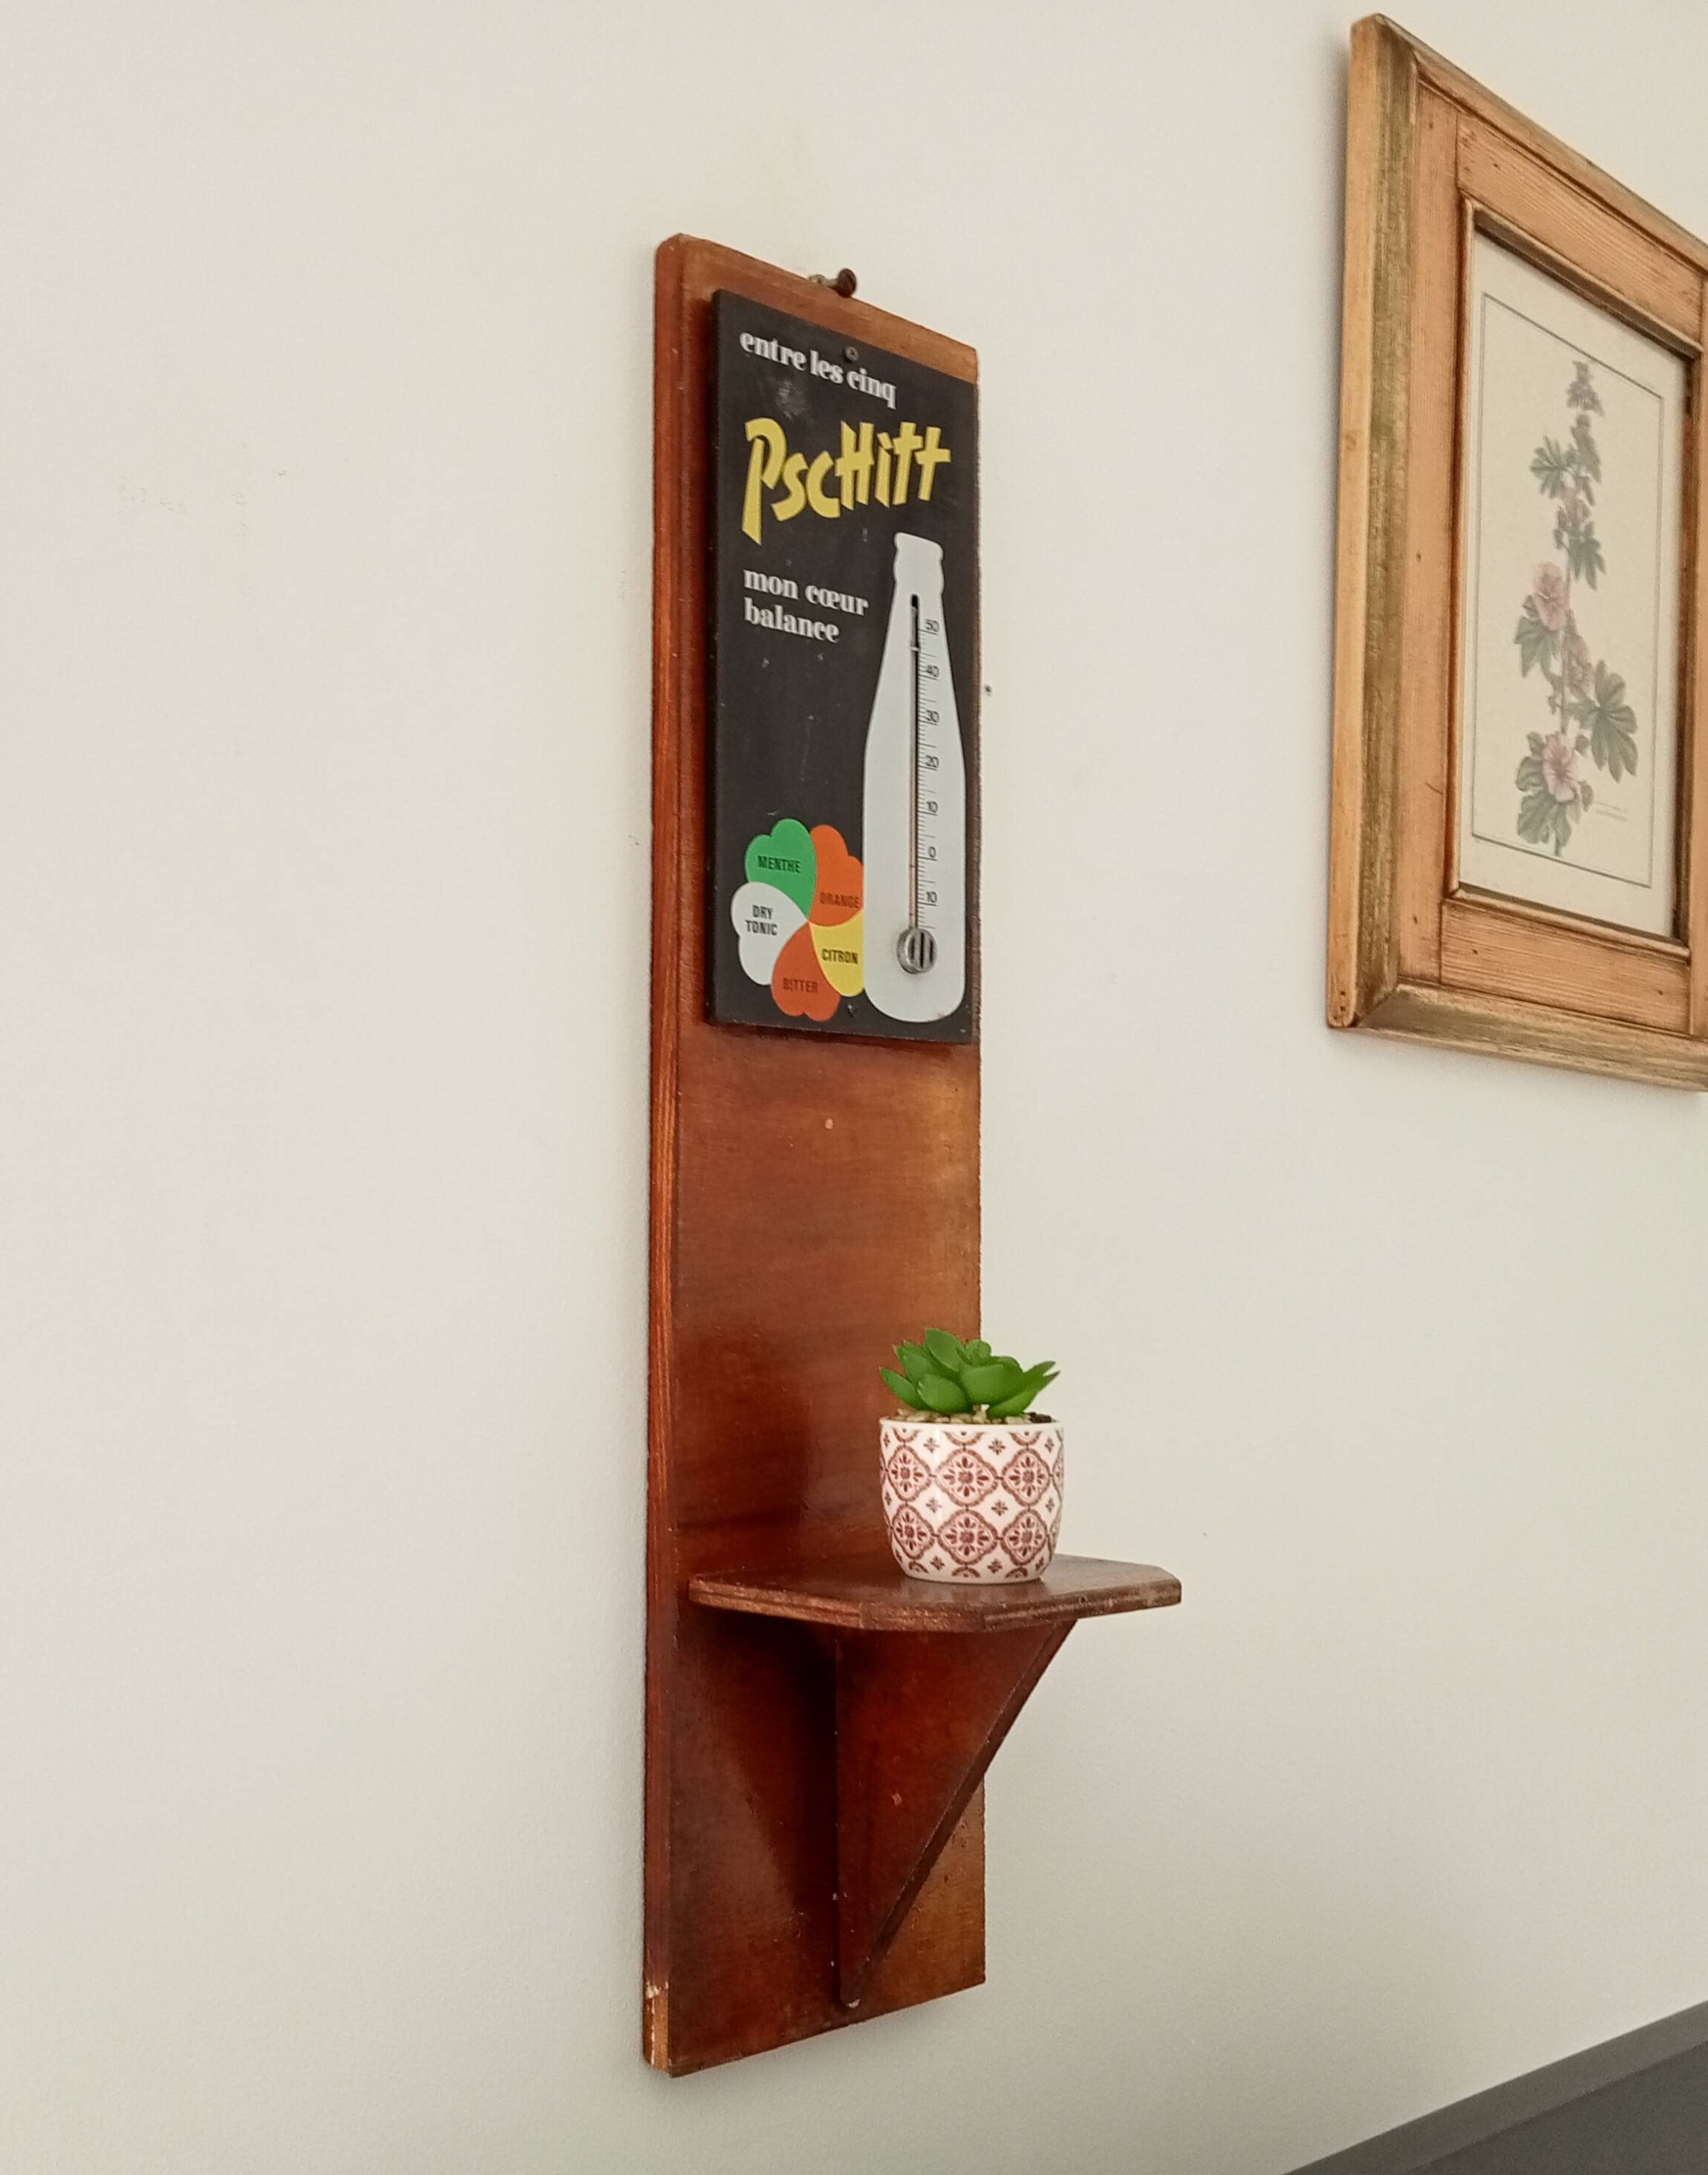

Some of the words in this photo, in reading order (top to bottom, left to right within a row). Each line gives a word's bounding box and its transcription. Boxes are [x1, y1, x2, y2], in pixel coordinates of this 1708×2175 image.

[740, 331, 806, 371] entre
[810, 350, 844, 385] les
[847, 368, 897, 410] cinq
[743, 569, 798, 600] mon
[805, 584, 870, 616] cœur
[744, 596, 840, 643] balance
[925, 619, 939, 632] 50
[926, 801, 938, 813] 10
[928, 846, 936, 858] 0
[757, 855, 801, 874] MENTHE
[819, 892, 859, 909] ORANGE
[926, 891, 937, 903] 10
[752, 904, 774, 920] DRY
[745, 919, 778, 936] TONIC
[821, 948, 858, 965] CITRON
[782, 977, 818, 994] BITTER
